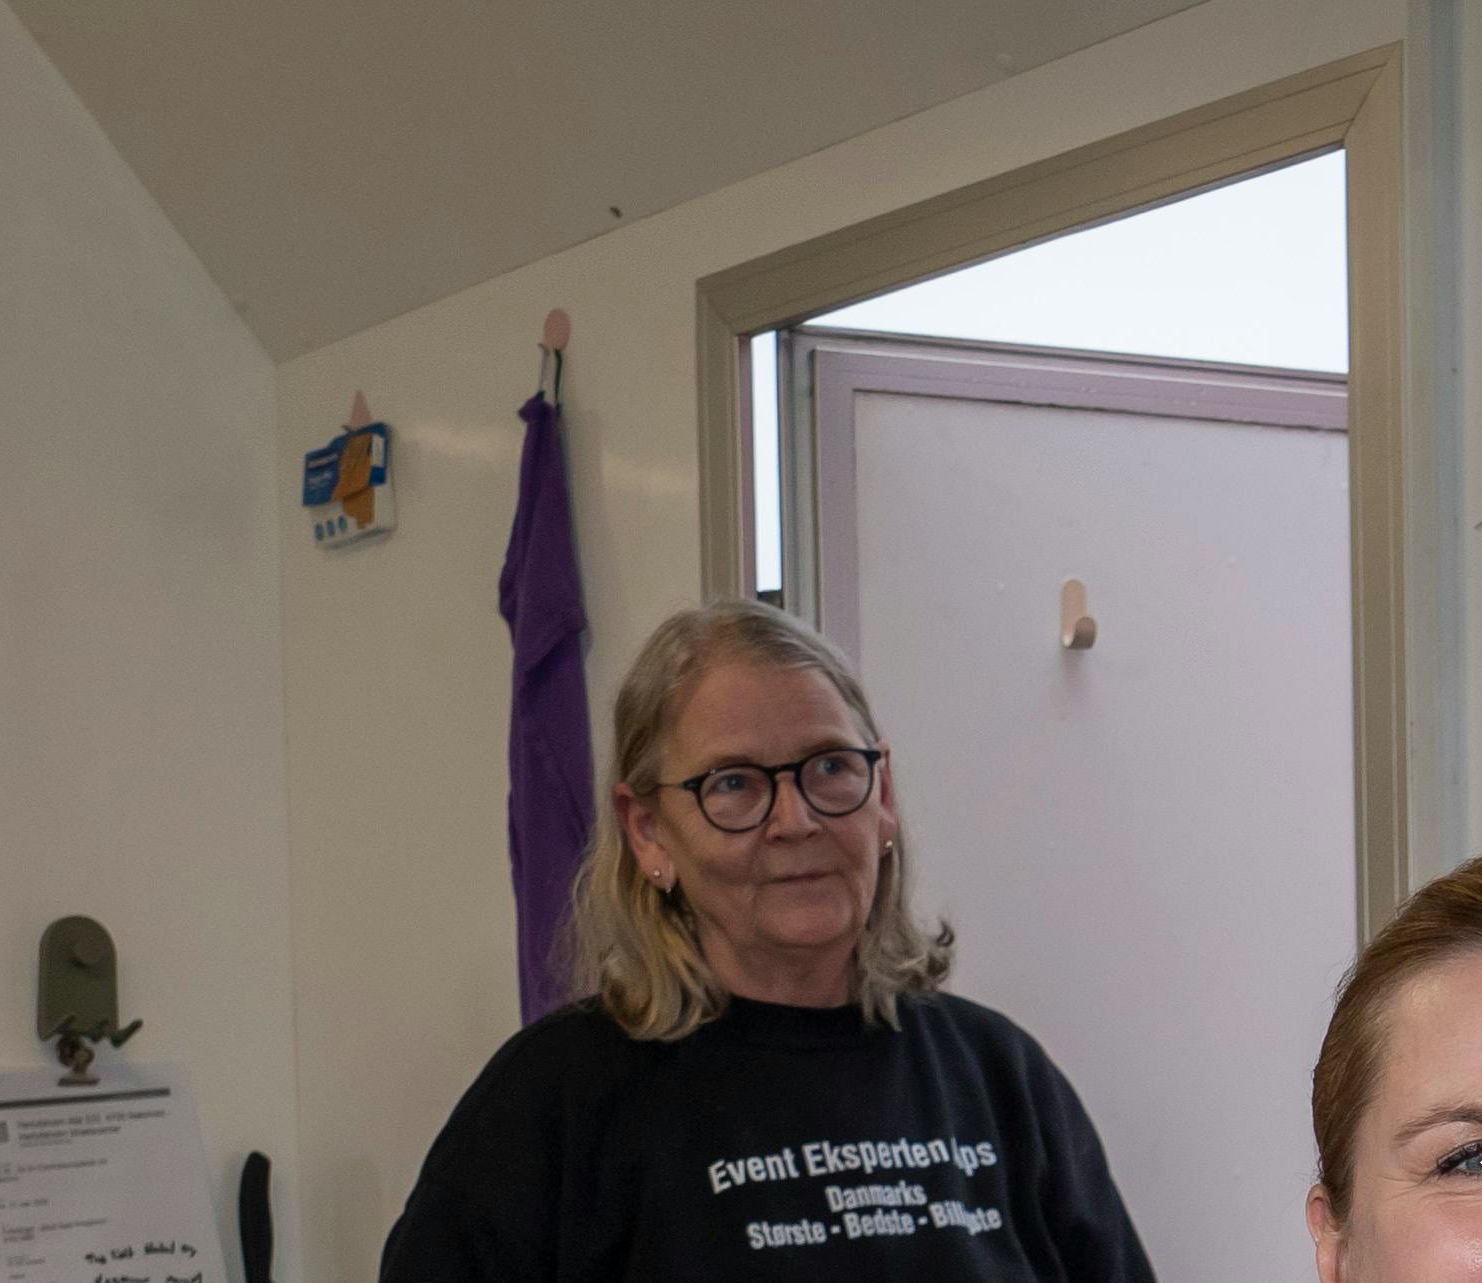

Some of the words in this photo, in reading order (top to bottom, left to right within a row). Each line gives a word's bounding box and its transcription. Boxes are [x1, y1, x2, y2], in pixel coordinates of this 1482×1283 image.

[708, 1147, 800, 1195] Event
[801, 1138, 950, 1177] Eksperten
[825, 1180, 928, 1213] Danmarks
[746, 1218, 827, 1250] Største
[843, 1207, 916, 1239] Bedste
